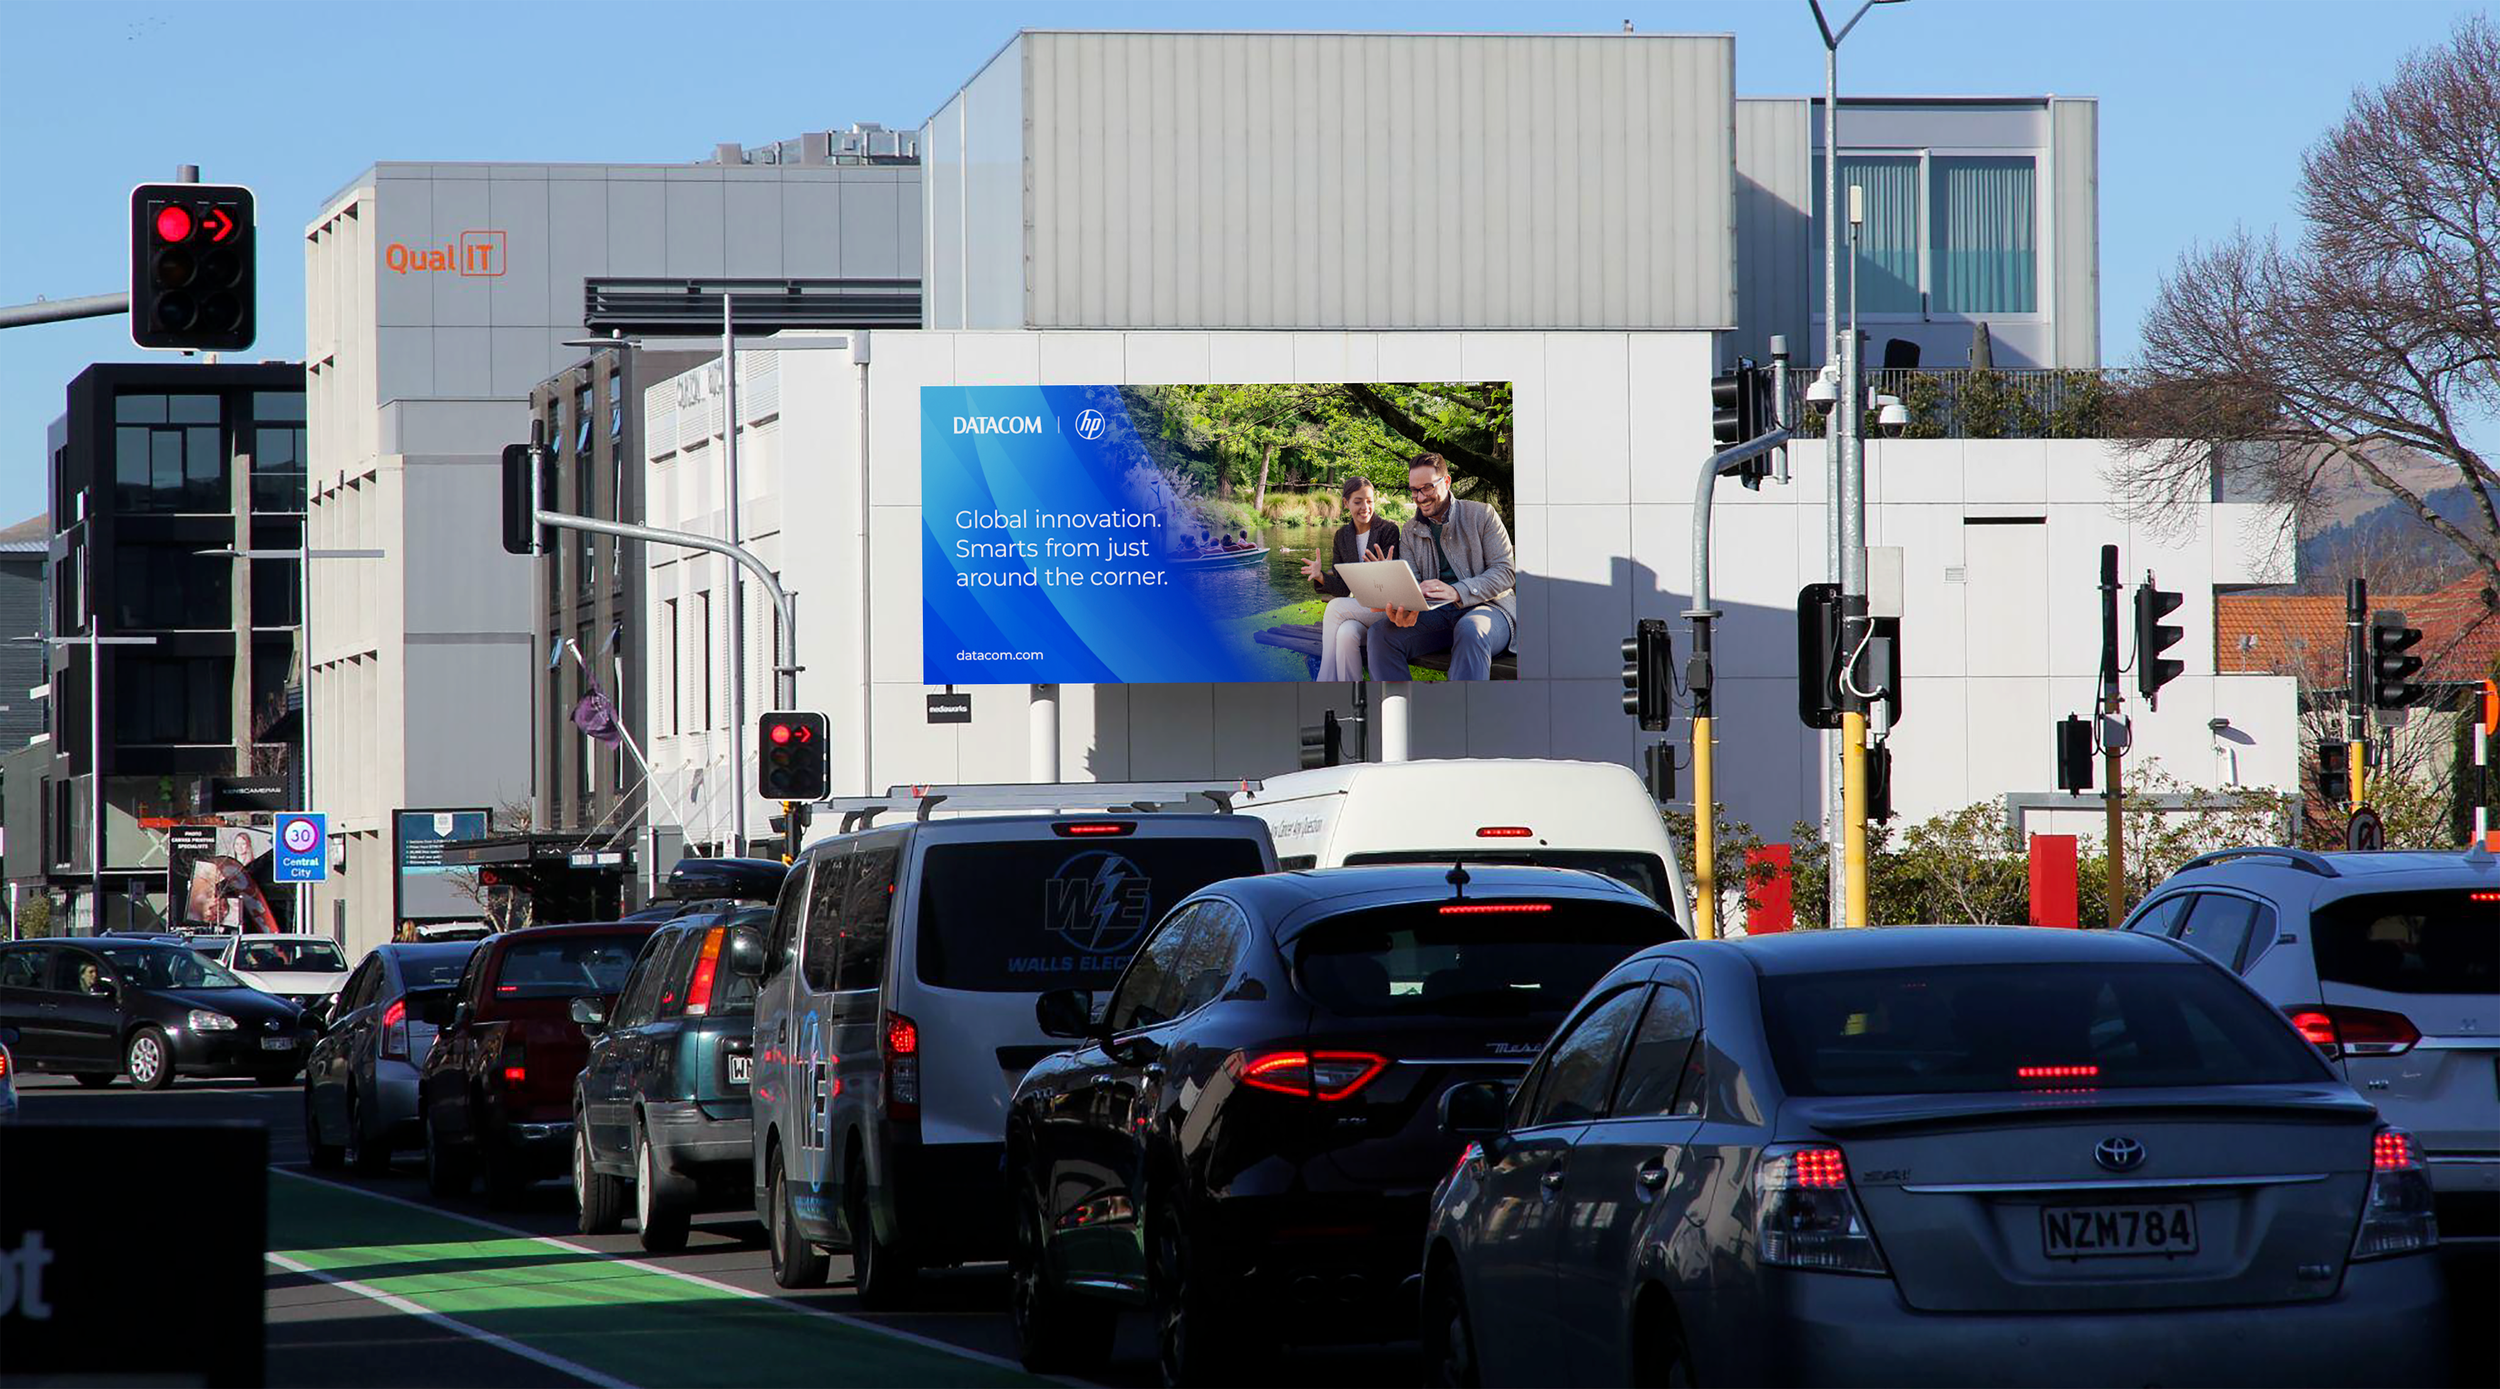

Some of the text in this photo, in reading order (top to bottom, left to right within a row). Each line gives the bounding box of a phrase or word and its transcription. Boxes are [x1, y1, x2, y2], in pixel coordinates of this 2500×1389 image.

[386, 243, 494, 274] Qual IT
[953, 415, 1043, 435] DATACOM
[1079, 409, 1102, 440] hp
[955, 508, 1162, 530] Global innovation.
[956, 537, 1150, 562] Smarts from just
[956, 566, 1168, 587] around the corner.
[956, 649, 1044, 661] datacom.com
[291, 829, 310, 842] 30
[283, 857, 319, 867] Central
[291, 868, 311, 878] City
[1007, 956, 1074, 973] WALLS
[2047, 1209, 2190, 1249] NZM784
